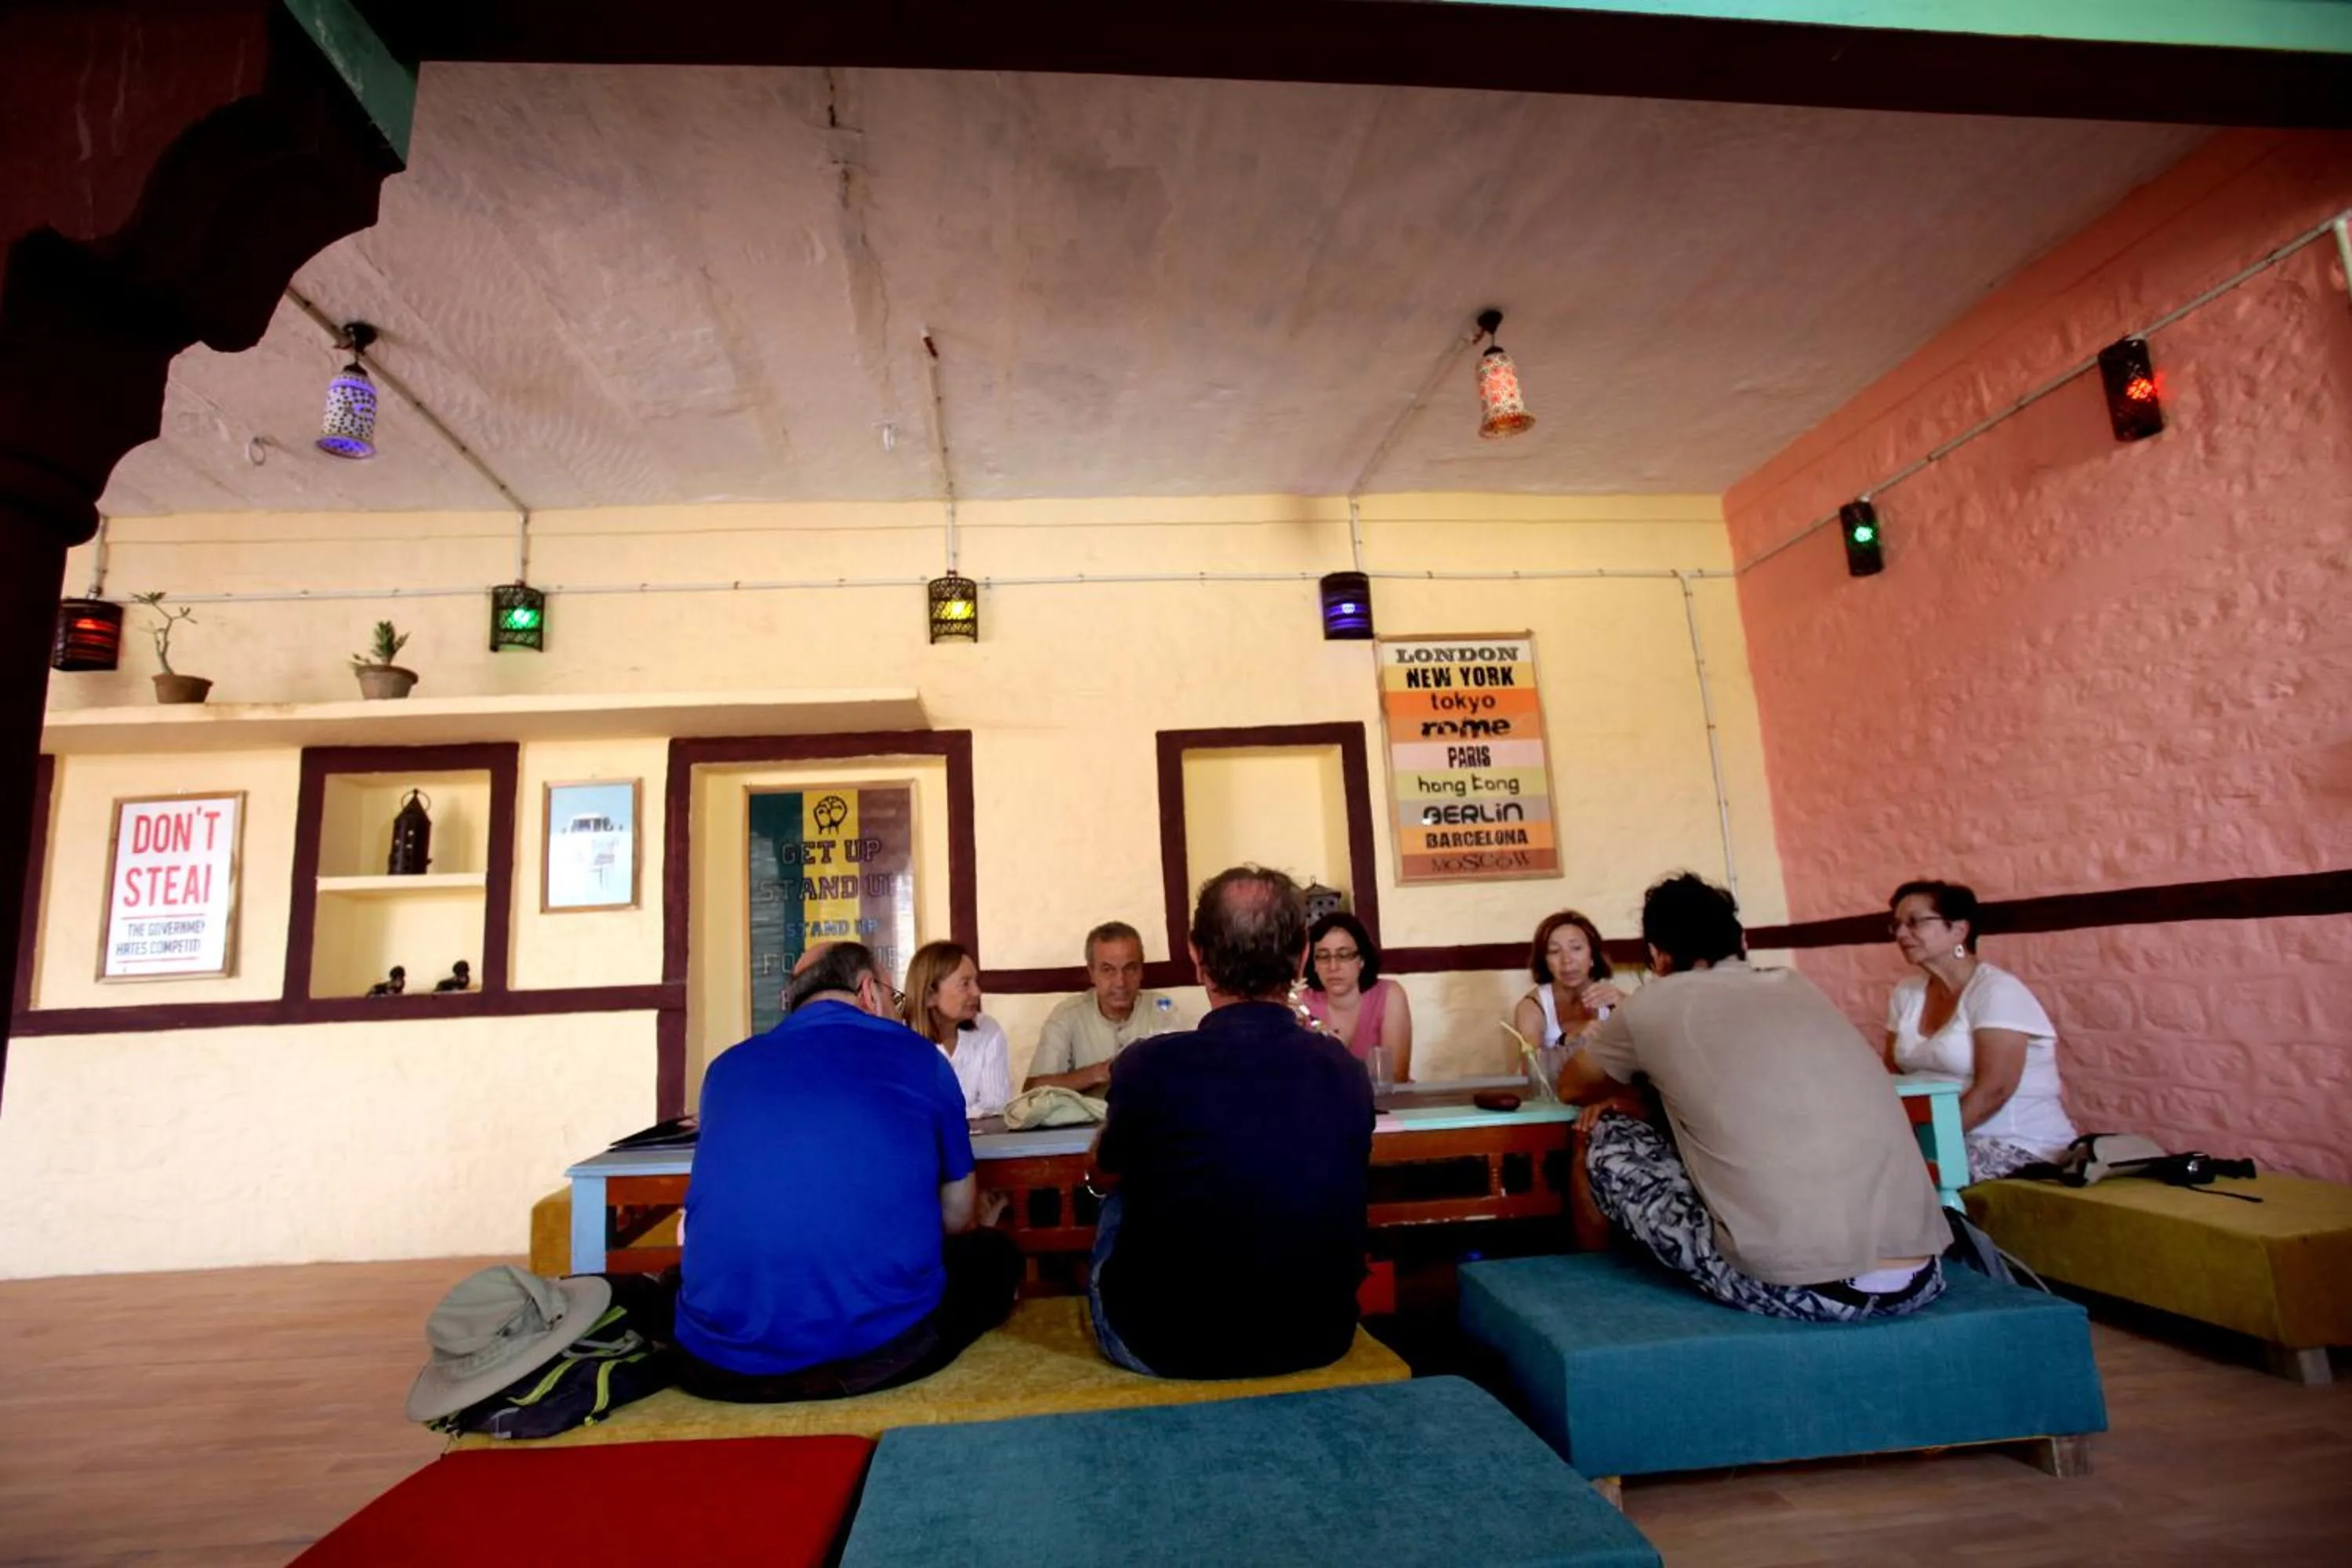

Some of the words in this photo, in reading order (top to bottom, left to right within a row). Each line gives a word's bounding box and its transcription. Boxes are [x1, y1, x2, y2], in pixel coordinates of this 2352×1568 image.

[1396, 647, 1519, 663] LONDON
[1406, 667, 1451, 688] NEW
[1459, 666, 1515, 687] YORK
[1431, 691, 1496, 714] tokyo
[1421, 717, 1512, 739] rome
[1447, 746, 1491, 768] PARIS
[1417, 775, 1466, 797] hong
[132, 806, 221, 854] DON'T
[1425, 829, 1529, 849] BARCELONA
[782, 838, 837, 865] GET
[844, 838, 882, 863] UP
[759, 875, 859, 901] STAND
[128, 923, 146, 937] THE
[786, 919, 851, 938] STAND
[855, 919, 880, 936] UP
